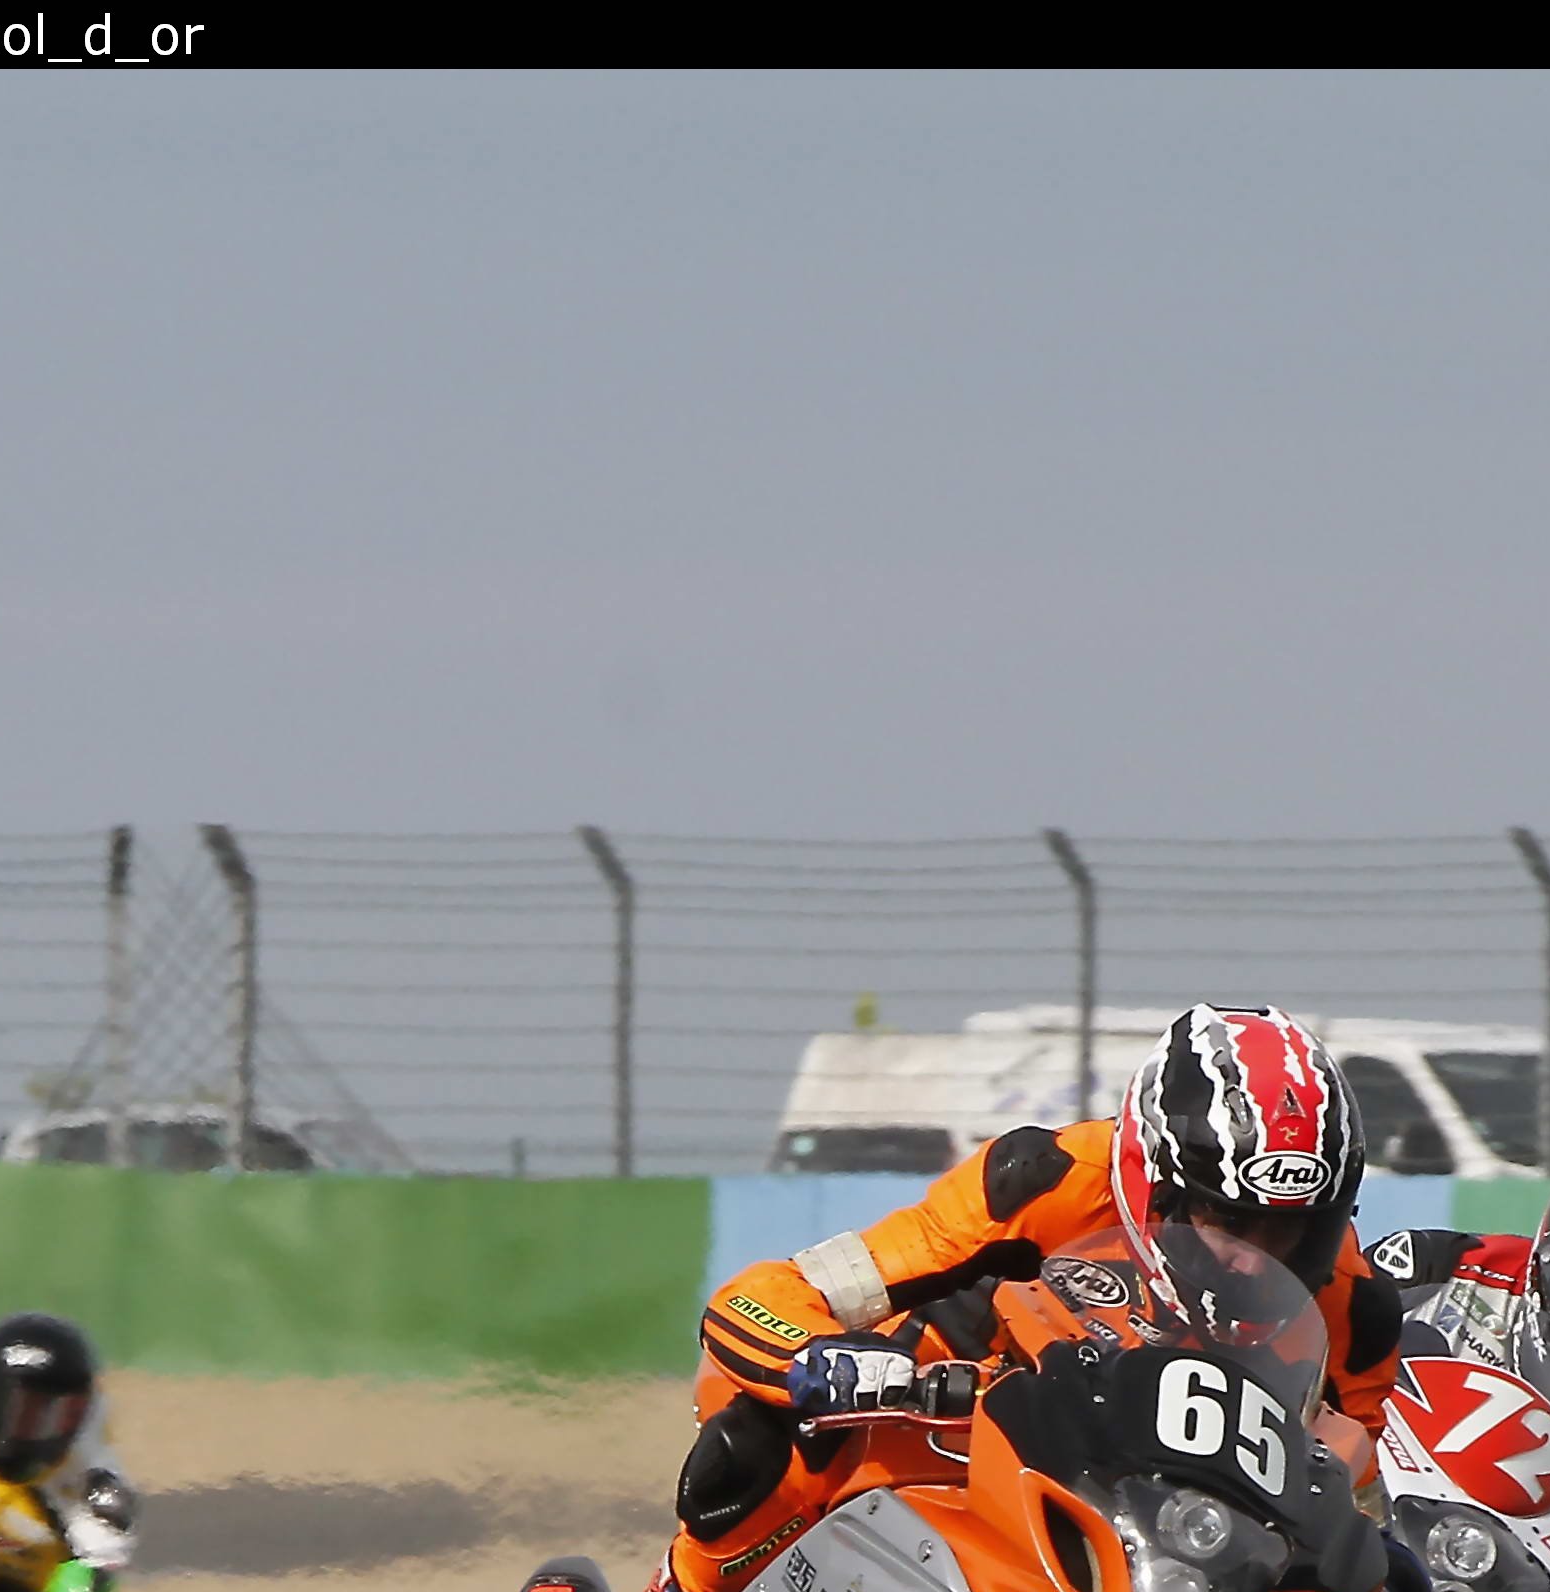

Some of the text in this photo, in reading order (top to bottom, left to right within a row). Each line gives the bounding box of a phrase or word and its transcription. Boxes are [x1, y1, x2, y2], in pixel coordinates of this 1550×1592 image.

[1248, 1158, 1322, 1184] Arai
[1156, 1358, 1286, 1496] 65
[1383, 1427, 1418, 1472] OTUL
